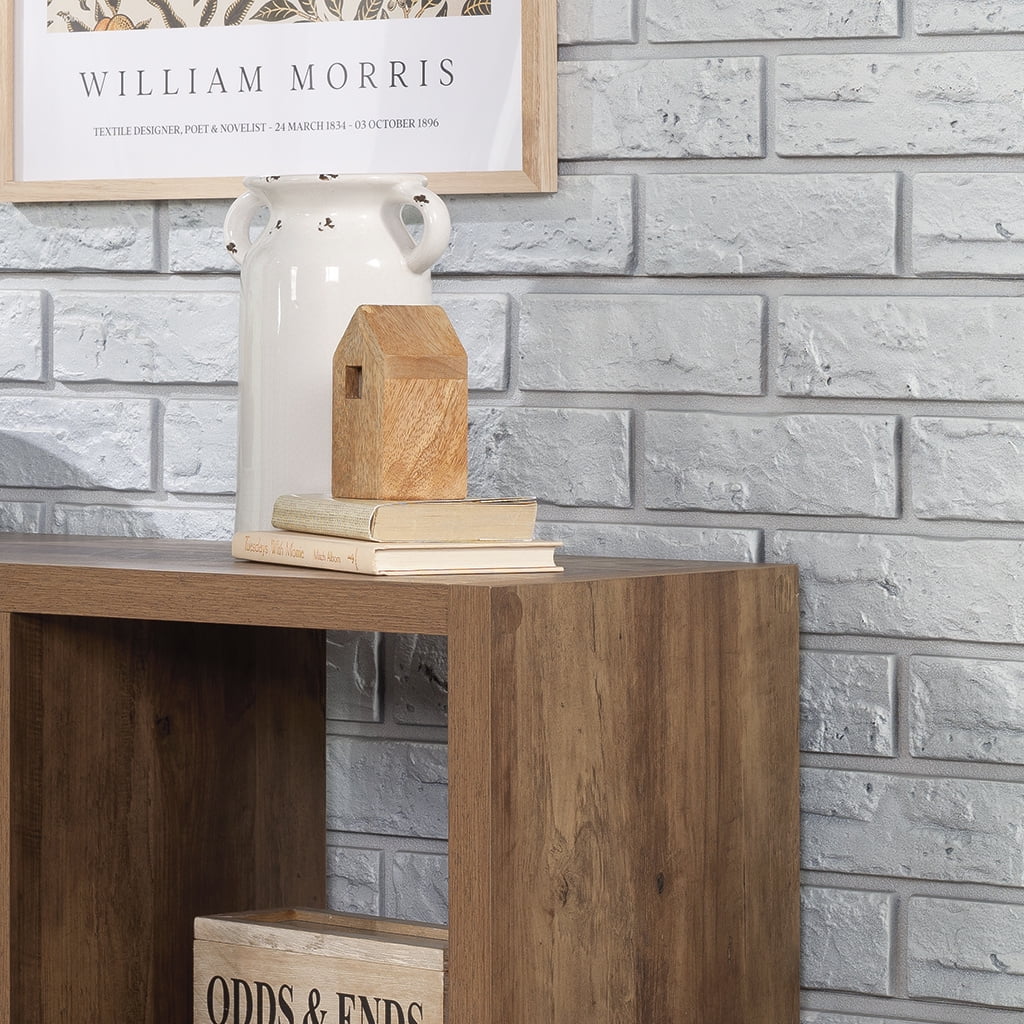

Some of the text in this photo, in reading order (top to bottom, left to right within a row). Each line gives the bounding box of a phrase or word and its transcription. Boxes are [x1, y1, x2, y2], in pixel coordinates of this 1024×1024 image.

[79, 58, 456, 98] WILLIAM MORRIS
[93, 126, 132, 137] TEXTILE
[133, 125, 183, 136] DESIGNER,
[184, 124, 209, 135] POET
[211, 124, 219, 134] &
[220, 122, 267, 134] NOVELIST
[274, 122, 286, 132] 24
[287, 120, 324, 131] MARCH
[325, 120, 347, 131] 1834
[354, 119, 367, 130] 03
[368, 118, 416, 129] OCTOBER
[417, 117, 440, 128] 1896
